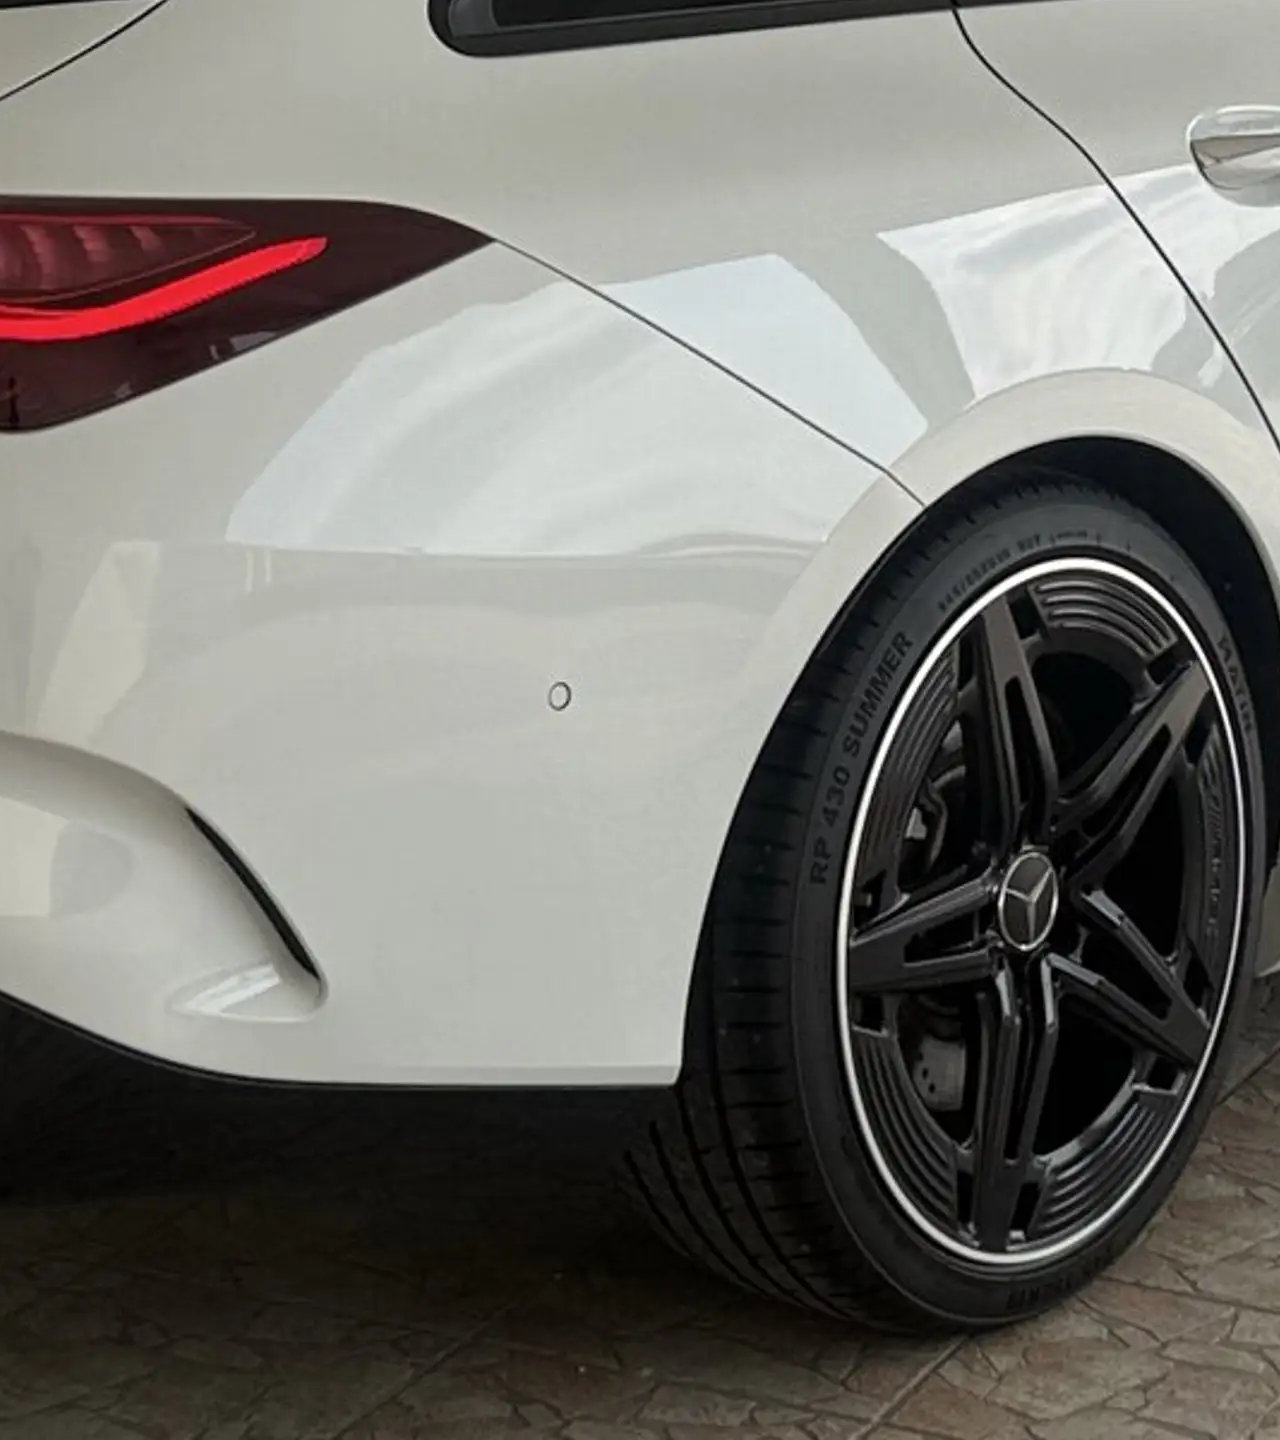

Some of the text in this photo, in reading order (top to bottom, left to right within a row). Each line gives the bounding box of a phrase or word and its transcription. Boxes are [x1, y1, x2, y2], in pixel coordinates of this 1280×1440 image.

[809, 631, 913, 885] RP 430 SUMMER
